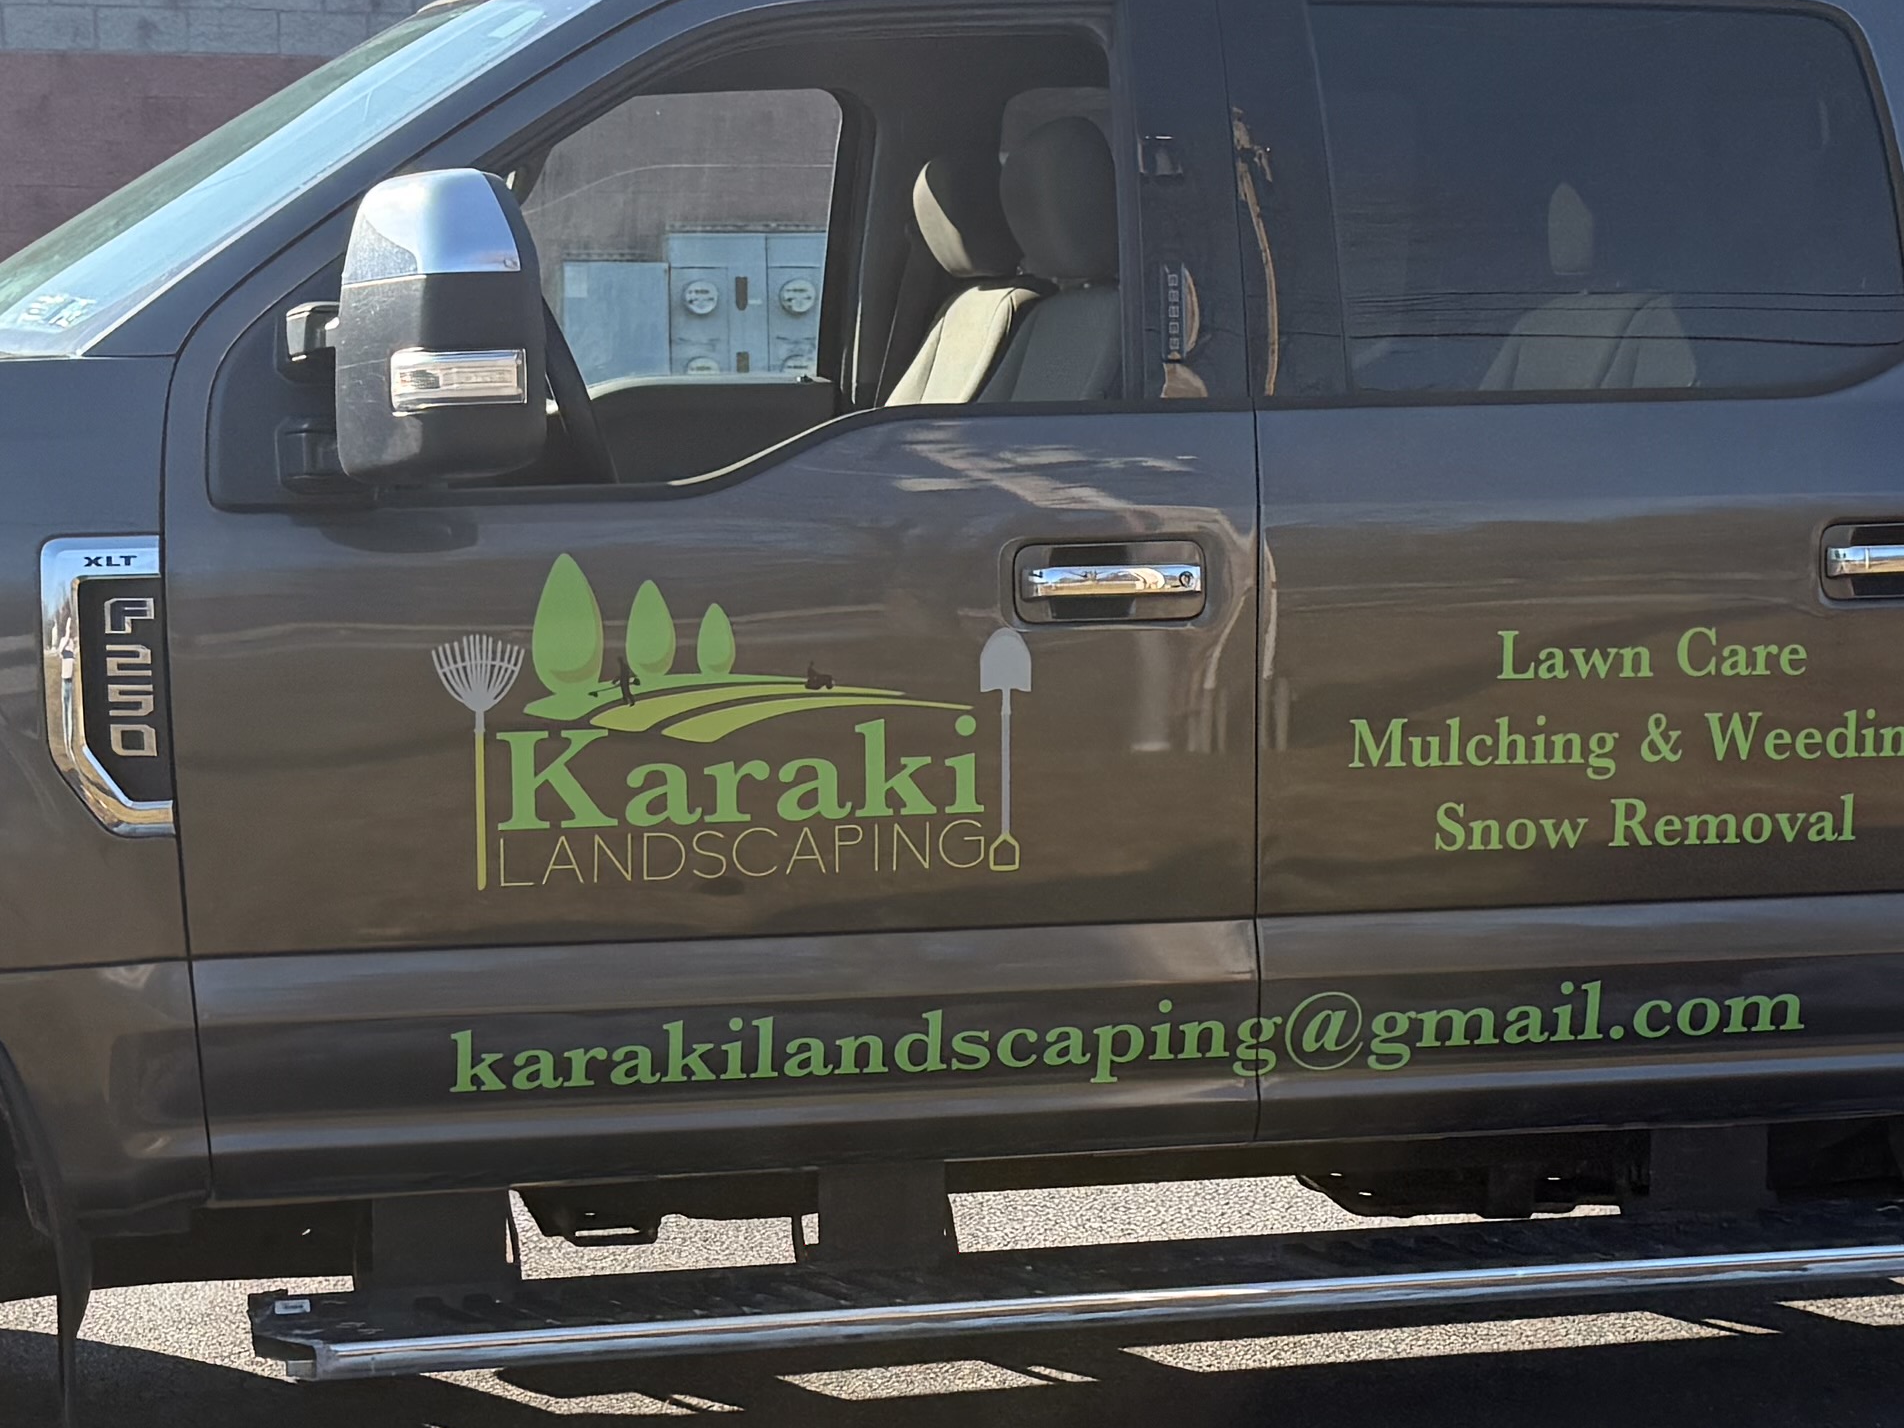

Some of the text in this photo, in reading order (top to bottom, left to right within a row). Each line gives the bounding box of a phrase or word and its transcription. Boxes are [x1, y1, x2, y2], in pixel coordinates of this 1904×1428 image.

[82, 554, 138, 568] XLT
[103, 597, 158, 757] F250
[1498, 626, 1808, 681] Lawn Care
[496, 714, 986, 831] Karaki
[1348, 715, 1619, 781] Mulching
[1639, 713, 1683, 763] &
[497, 818, 987, 888] LANDSCAPING
[1434, 793, 1857, 852] Snow Removal
[449, 980, 1805, 1093] karakilandscaping@gmail.com
